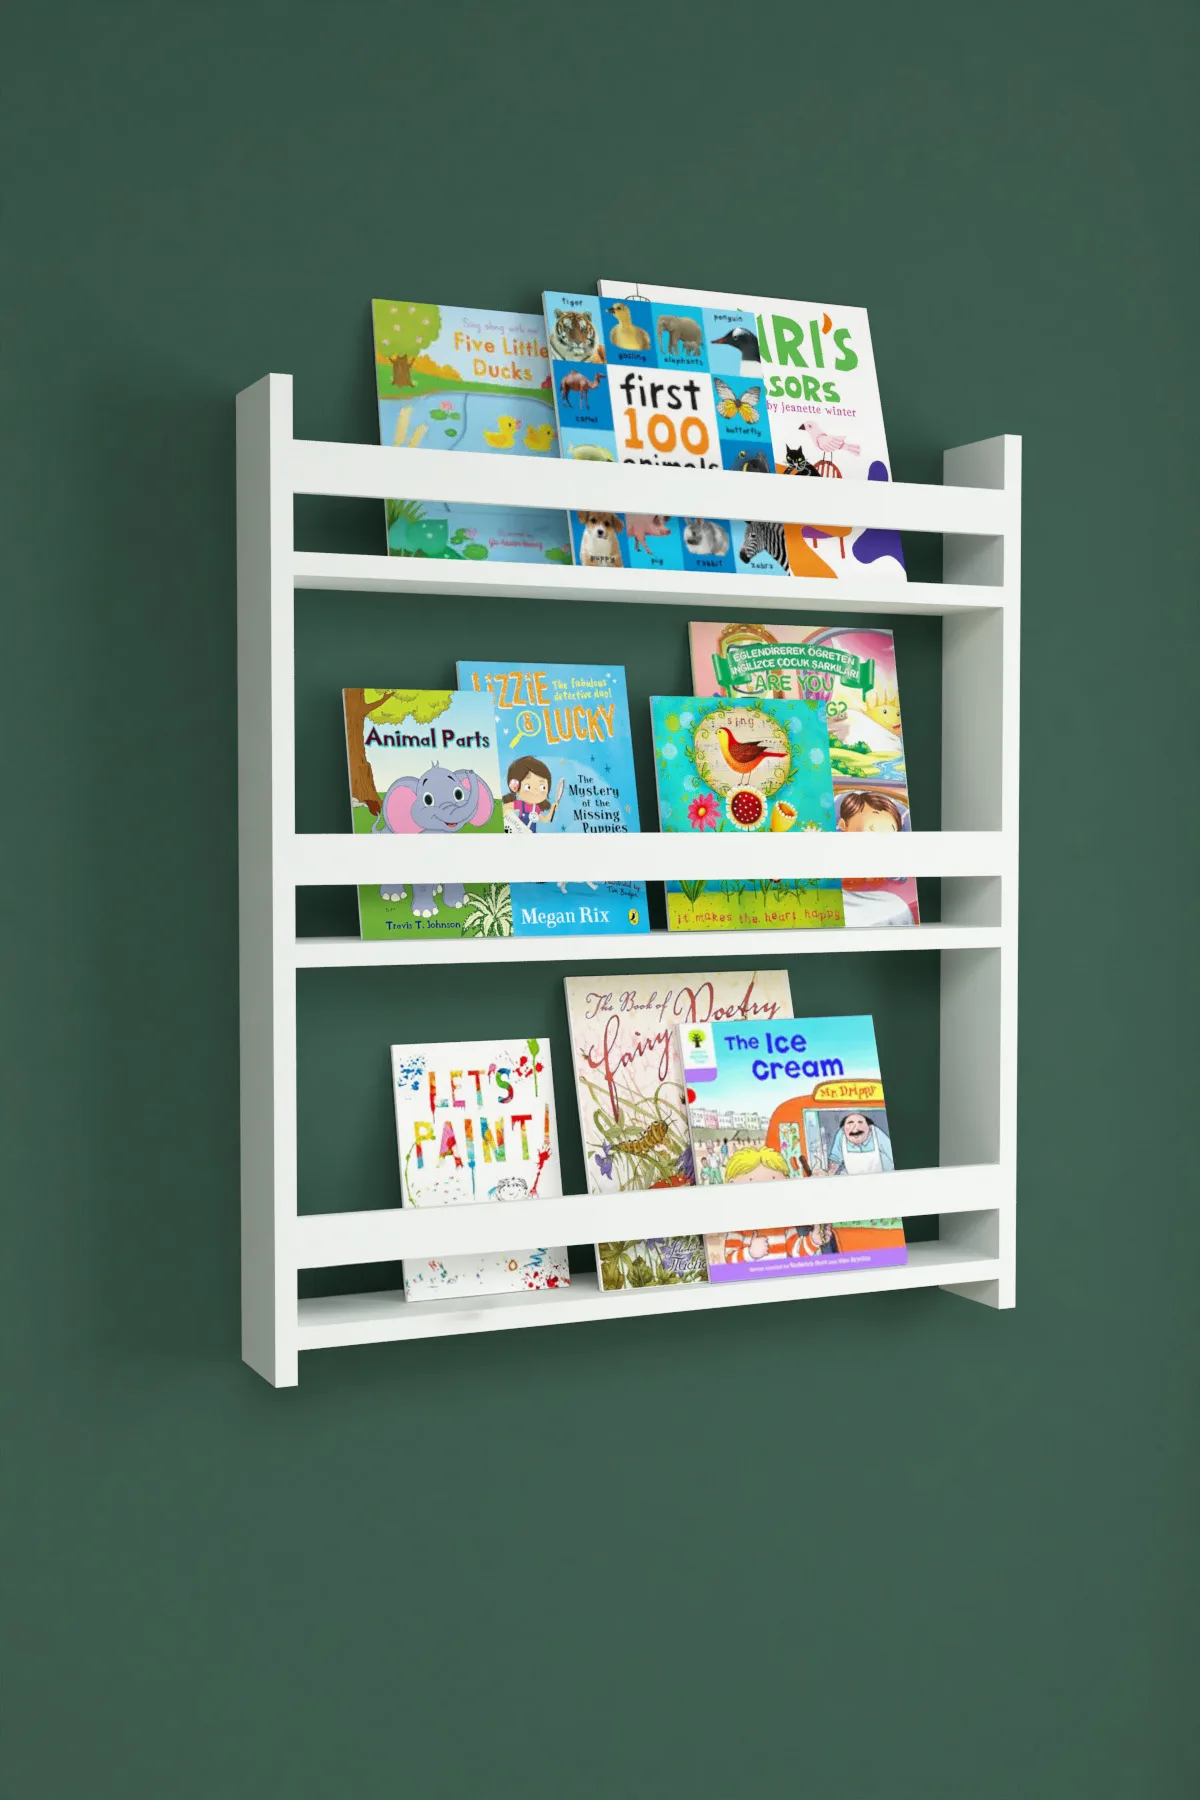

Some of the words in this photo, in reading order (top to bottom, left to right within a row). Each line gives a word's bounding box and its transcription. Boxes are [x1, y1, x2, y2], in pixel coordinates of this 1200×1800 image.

[562, 297, 583, 306] tiger
[713, 313, 743, 322] penguin
[463, 317, 481, 333] Sing
[485, 320, 505, 335] along
[454, 332, 495, 353] Five
[502, 336, 549, 358] Little
[617, 352, 647, 362] gosling
[664, 357, 704, 366] elephants
[473, 358, 533, 381] Ducks
[620, 373, 701, 410] first
[764, 375, 841, 403] SORS
[766, 401, 778, 412] by
[781, 402, 821, 414] jeanette
[825, 406, 857, 417] winter
[623, 407, 710, 455] 100
[725, 426, 762, 437] butterfly
[590, 554, 616, 565] puppy
[651, 557, 664, 566] pig
[696, 558, 723, 567] rabbit
[751, 562, 774, 570] zebra
[552, 679, 568, 689] The
[571, 677, 608, 688] fabulous
[754, 674, 792, 692] ARE
[797, 674, 835, 692] YOU
[554, 691, 591, 701] detective
[594, 688, 613, 698] duo!
[523, 713, 535, 732] &
[543, 704, 615, 745] LUCKY
[727, 716, 755, 727] sing
[365, 726, 437, 748] Animal
[441, 729, 491, 748] Parts
[578, 774, 594, 783] The
[568, 784, 620, 798] Mystery
[595, 799, 610, 807] the
[573, 809, 620, 822] Missing
[521, 907, 576, 928] Megan
[579, 906, 610, 923] Rix
[677, 913, 689, 924] it
[695, 912, 732, 923] makes
[739, 913, 758, 924] the
[764, 911, 797, 923] heart
[804, 909, 841, 921] happy
[385, 921, 412, 930] Travis
[415, 920, 424, 929] T.
[427, 920, 461, 929] Johnson
[586, 993, 614, 1019] The
[620, 990, 656, 1012] Book
[655, 990, 673, 1022] of
[673, 972, 781, 1023] Poetry
[724, 1035, 760, 1051] The
[765, 1032, 807, 1054] Ice
[428, 1063, 514, 1115] LET'S
[839, 1084, 876, 1100] Drippy
